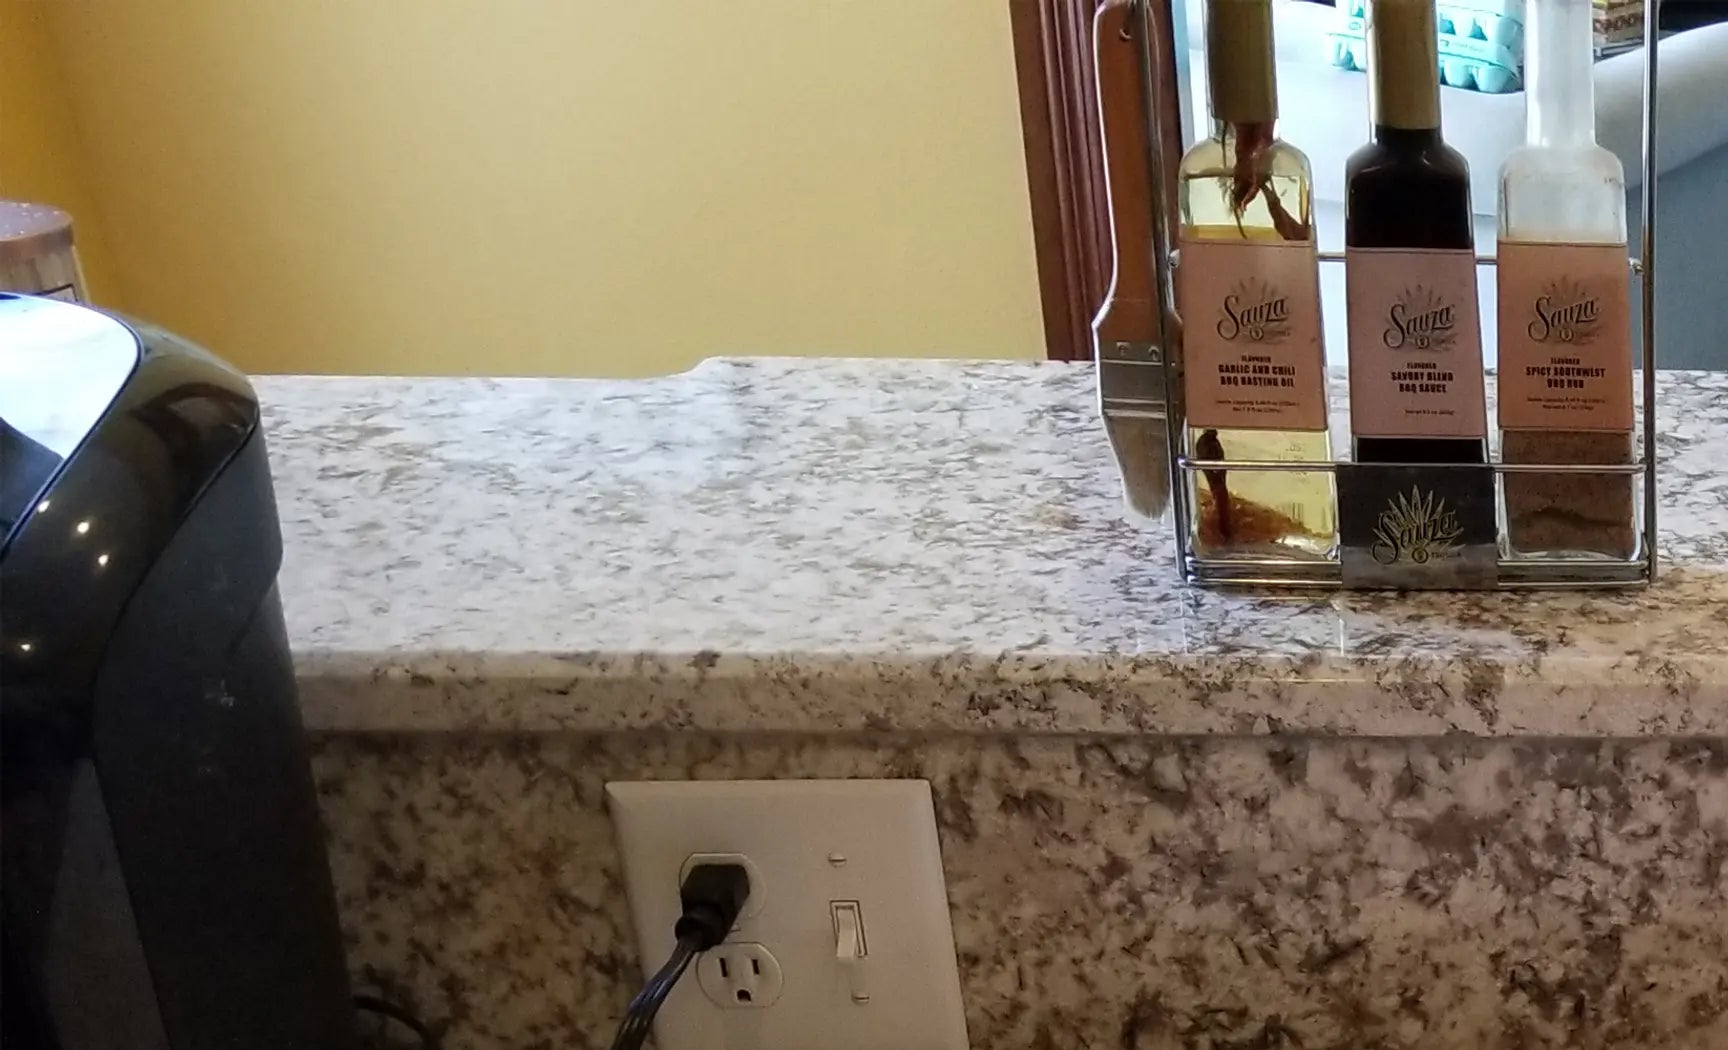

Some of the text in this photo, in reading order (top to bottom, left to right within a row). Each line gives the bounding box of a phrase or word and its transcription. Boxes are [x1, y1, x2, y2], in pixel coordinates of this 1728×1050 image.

[1217, 295, 1288, 340] Sauza
[1527, 296, 1599, 342] Sauza
[1383, 303, 1455, 349] Sauza
[1218, 364, 1296, 376] GARLIC AND CHILI
[1391, 371, 1424, 381] SAVORY
[1526, 366, 1606, 378] SPICY SOUTHWEST
[1241, 376, 1279, 388] BASTING
[1281, 377, 1295, 388] OIL
[1419, 384, 1447, 394] SAUCE
